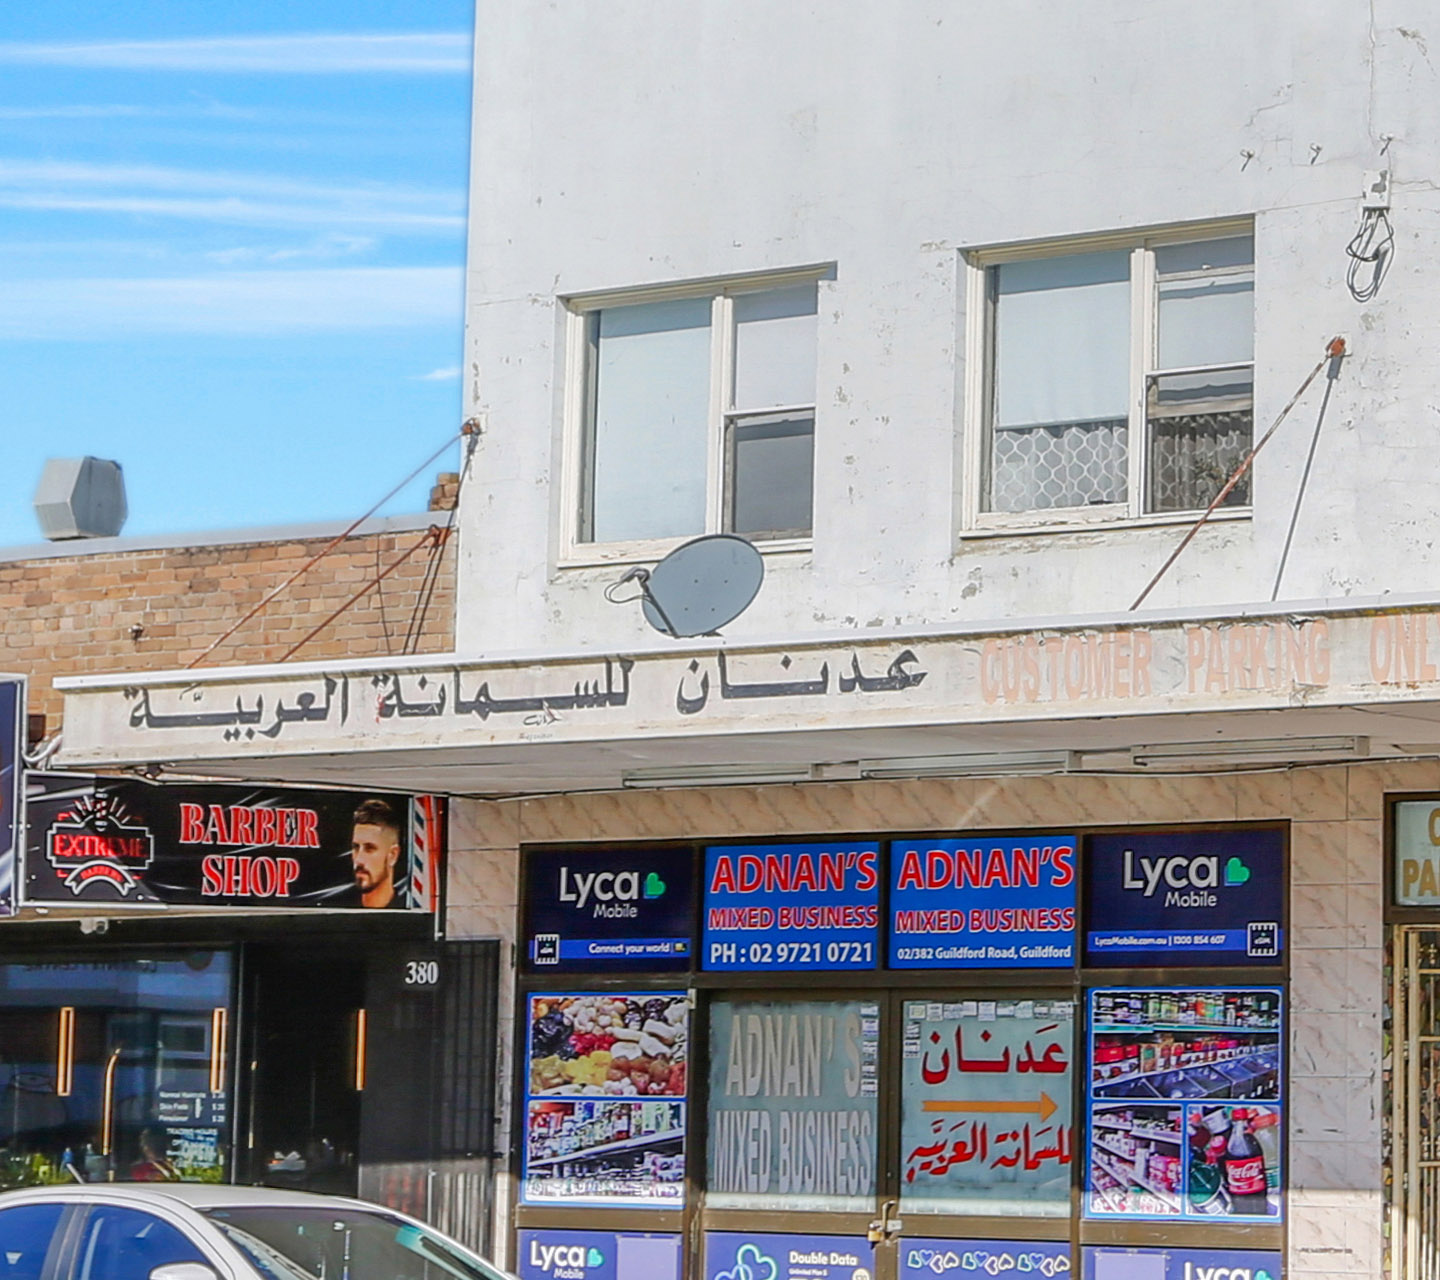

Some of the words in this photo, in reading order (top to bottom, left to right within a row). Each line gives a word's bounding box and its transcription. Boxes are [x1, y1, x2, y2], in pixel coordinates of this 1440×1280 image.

[981, 628, 1152, 704] CUSTOMER
[1187, 618, 1331, 694] PARKING
[676, 648, 930, 716] عدنان
[179, 803, 320, 849] BARBER
[54, 834, 148, 858] EXTREME
[201, 857, 300, 898] SHOP
[710, 851, 878, 894] ADNAN'S
[896, 846, 1074, 891] ADNAN'S
[1123, 851, 1218, 897] Lyca
[560, 866, 640, 908] Lyca
[1164, 891, 1217, 908] Mobile
[593, 904, 637, 918] Mobile
[708, 907, 774, 930] MIXED
[777, 905, 879, 930] BUSINESS
[895, 909, 965, 933] MIXED
[969, 907, 1075, 933] BUSINESS
[588, 943, 624, 953] Connect
[625, 945, 645, 955] your
[646, 943, 669, 952] world
[710, 943, 737, 963] PH
[749, 943, 773, 963] 02
[776, 942, 821, 963] 9721
[827, 942, 872, 962] 0721
[897, 948, 934, 960] 02/382
[935, 946, 986, 959] Guildford
[987, 946, 1018, 960] Road,
[1019, 945, 1071, 958] Guildford
[405, 961, 439, 984] 380
[714, 1111, 772, 1193] MIXED
[779, 1110, 872, 1196] BUSINESS
[530, 1240, 585, 1271] Lyca
[790, 1251, 828, 1265] Double
[830, 1253, 858, 1266] Data
[553, 1268, 584, 1280] Mobile
